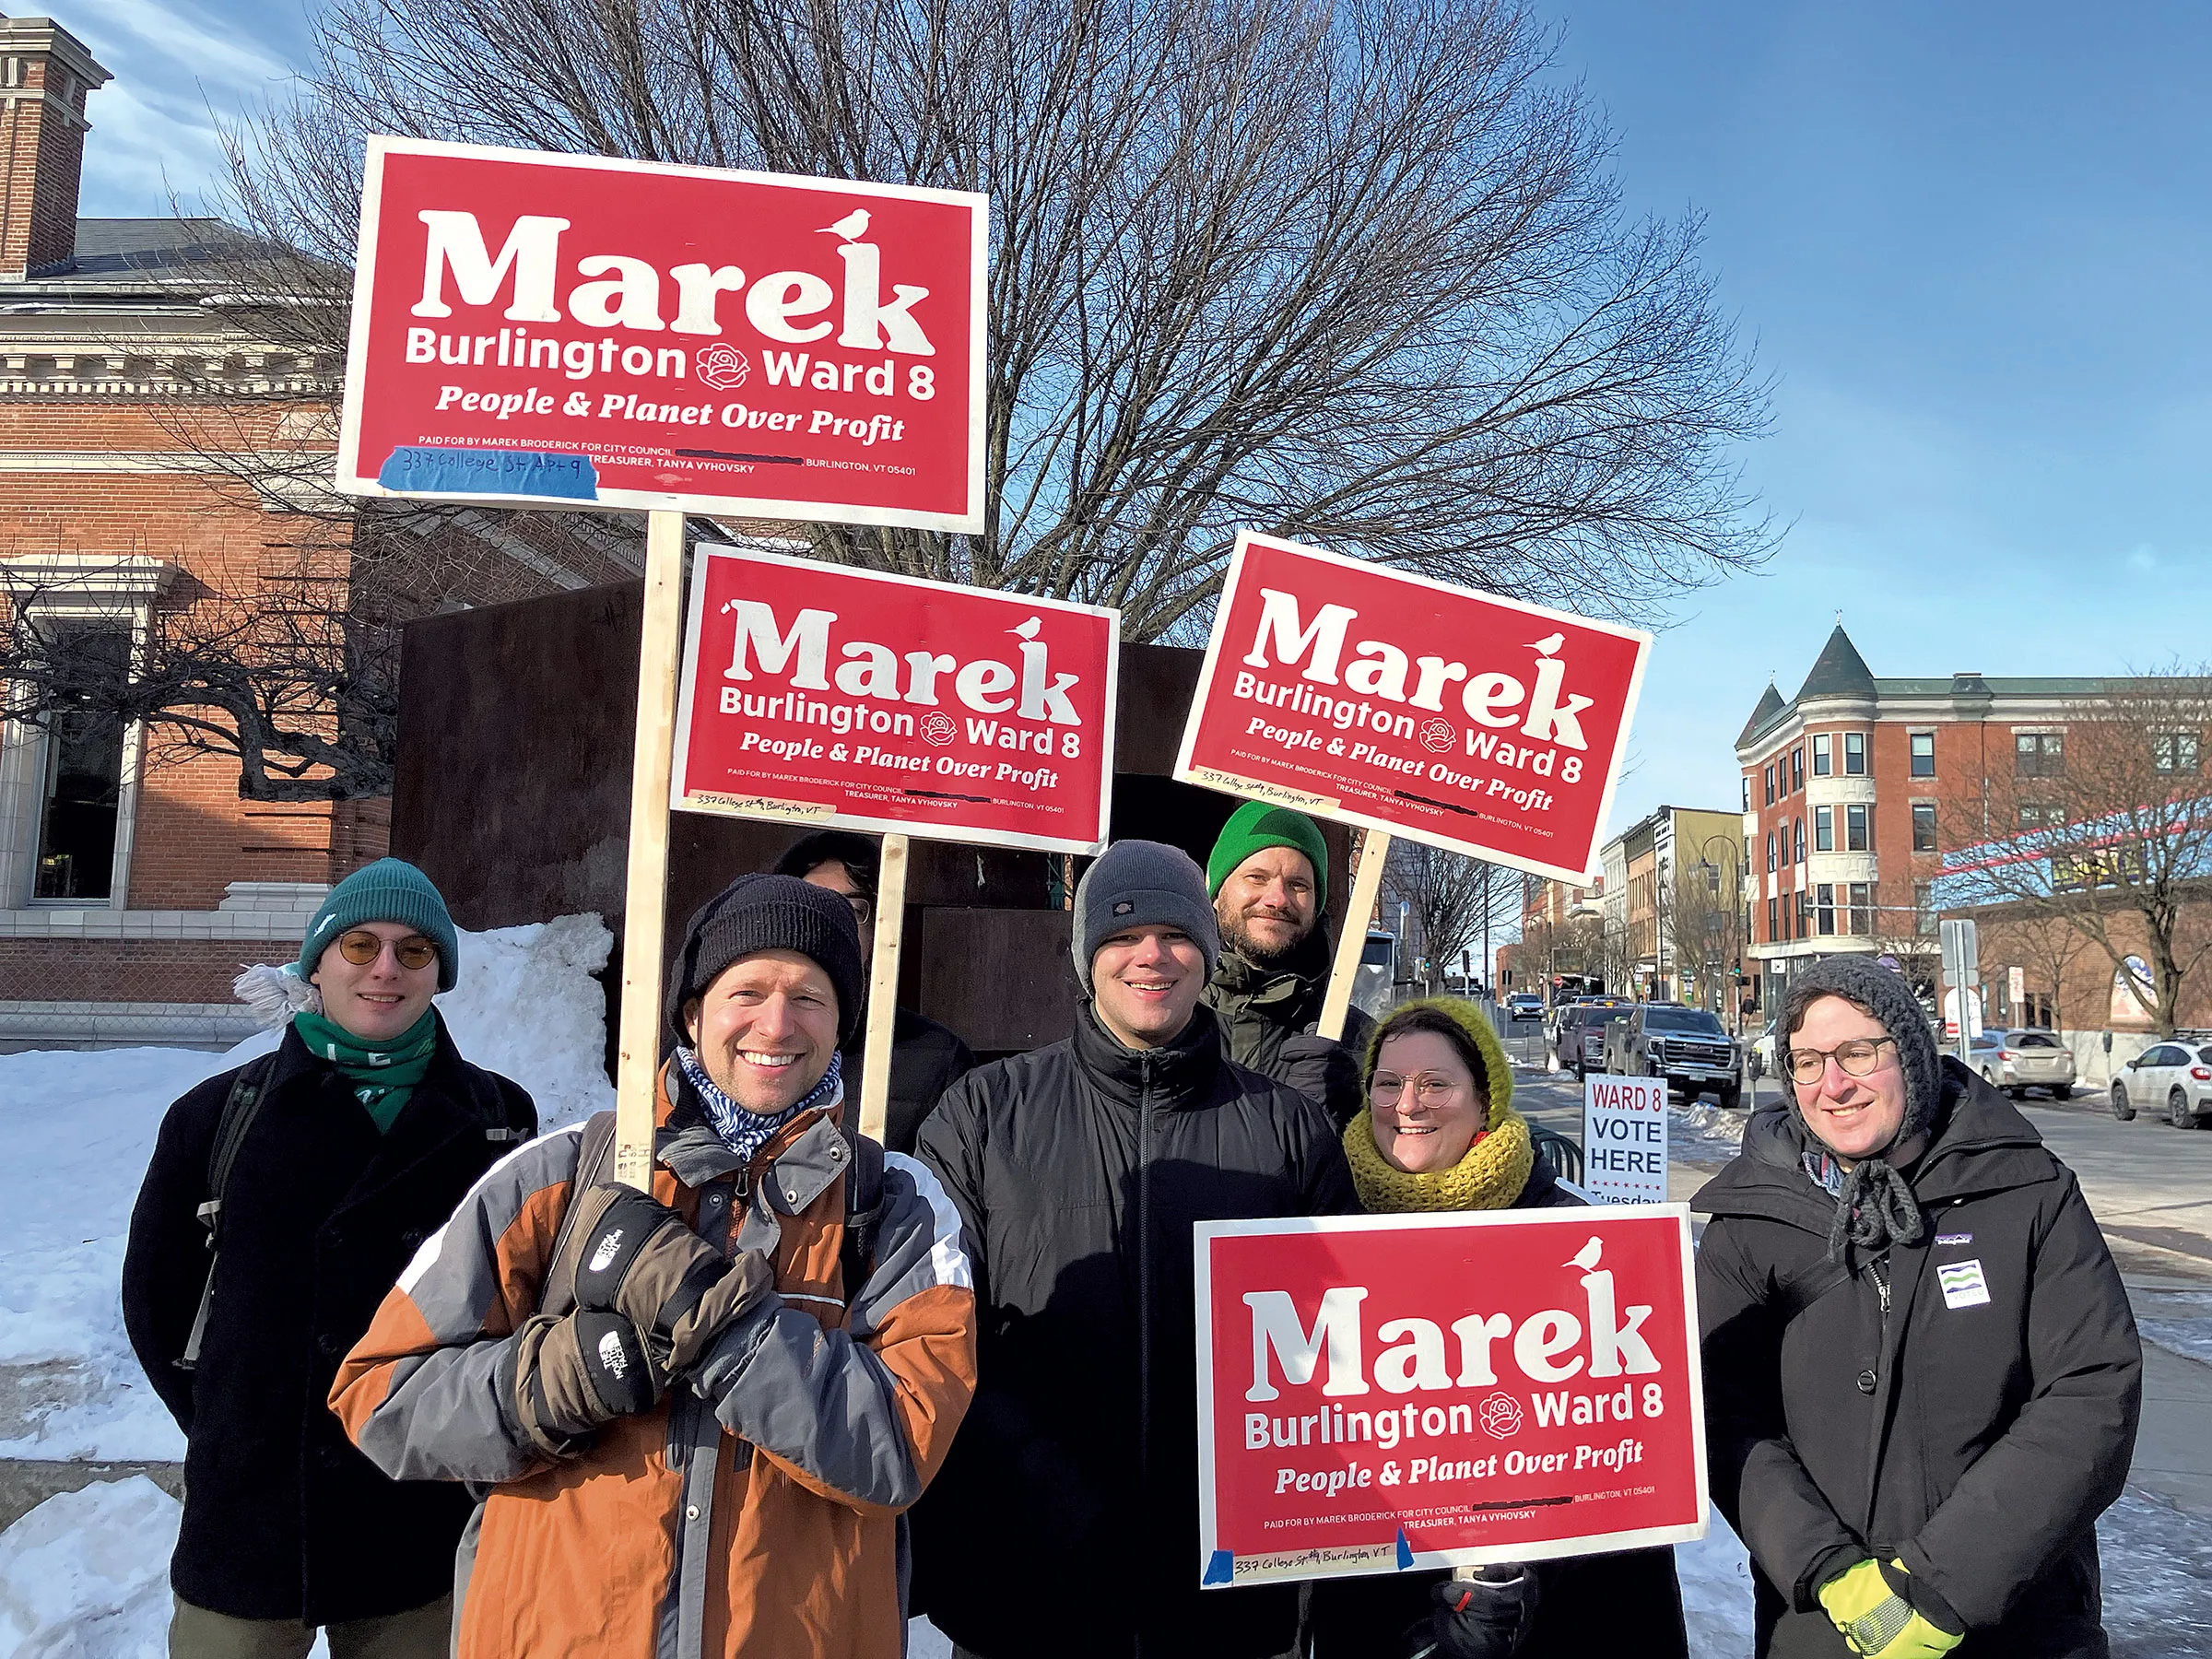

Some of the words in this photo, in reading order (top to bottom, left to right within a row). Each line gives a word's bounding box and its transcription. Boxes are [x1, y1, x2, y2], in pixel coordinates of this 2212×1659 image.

[410, 209, 935, 356] Marek
[405, 326, 686, 380] Burlington
[761, 349, 894, 396] Ward
[907, 364, 935, 400] 8
[434, 385, 554, 420] People
[562, 391, 592, 418] &
[597, 393, 713, 425] Planet
[720, 403, 803, 431] Over
[806, 409, 905, 446] Profit
[403, 449, 433, 471] 337
[439, 453, 499, 472] College
[571, 460, 581, 479] 9
[418, 435, 443, 444] PAID
[443, 436, 465, 445] FOR
[465, 436, 480, 445] BY
[481, 437, 518, 446] MAREK
[520, 438, 579, 453] BRODERICK
[580, 441, 602, 451] FOR
[603, 442, 627, 453] CITY
[872, 464, 886, 472] VT
[886, 465, 915, 476] 05401
[655, 457, 693, 469] TANYA
[695, 461, 754, 473] VYHOVSKY
[723, 598, 1082, 726] Marek
[1241, 587, 1594, 750] Marek
[718, 686, 913, 736] Burlington
[964, 717, 1053, 755] Ward
[1061, 732, 1080, 759] 8
[1232, 670, 1415, 739] Burlington
[1465, 727, 1557, 777] Ward
[1560, 755, 1583, 783] 8
[738, 731, 823, 761] People
[828, 742, 849, 762] &
[852, 745, 931, 771] Planet
[935, 756, 992, 778] Over
[994, 761, 1058, 791] Profit
[1201, 771, 1222, 782] 337
[1244, 716, 1323, 750] People
[1325, 736, 1346, 757] &
[1347, 741, 1425, 776] Planet
[1428, 762, 1483, 791] Over
[1484, 777, 1553, 811] Profit
[697, 794, 717, 805] 337
[726, 767, 746, 775] PAID
[745, 769, 760, 777] FOR
[760, 771, 771, 779] BY
[771, 772, 798, 782] MAREK
[798, 775, 840, 786] BRODERICK
[840, 780, 855, 788] FOR
[854, 782, 872, 790] CITY
[1044, 805, 1064, 813] 05401
[890, 794, 916, 804] TANYA
[916, 797, 958, 808] VYHOVSKY
[1230, 747, 1247, 758] PAID
[1246, 752, 1261, 761] FOR
[1270, 759, 1294, 770] MAREK
[1294, 764, 1333, 779] BRODERICK
[1332, 773, 1347, 782] FOR
[1347, 777, 1363, 786] CITY
[1524, 824, 1533, 832] VT
[1532, 827, 1554, 838] 05401
[1380, 794, 1404, 806] TANYA
[1405, 801, 1444, 817] VYHOVSKY
[1592, 1083, 1646, 1112] WARD
[1652, 1088, 1662, 1112] 8
[1592, 1116, 1662, 1144] VOTE
[1591, 1147, 1662, 1175] HERE
[1591, 1190, 1662, 1205] Tuesda
[1953, 1289, 1984, 1300] VOTED
[1241, 1268, 1661, 1402] Marek
[1244, 1402, 1473, 1450] Burlington
[1530, 1382, 1633, 1428] Ward
[1641, 1382, 1664, 1418] 8
[1274, 1461, 1371, 1497] People
[1378, 1460, 1402, 1486] &
[1407, 1453, 1498, 1484] Planet
[1503, 1450, 1568, 1475] Over
[1572, 1438, 1643, 1473] Profit
[1264, 1519, 1284, 1529] PAID
[1284, 1517, 1302, 1527] FOR
[1302, 1516, 1314, 1525] BY
[1315, 1514, 1347, 1524] MAREK
[1347, 1511, 1396, 1522] BRODERICK
[1396, 1509, 1414, 1518] FOR
[1414, 1507, 1433, 1517] CITY
[1622, 1488, 1632, 1496] VT
[1632, 1485, 1655, 1495] 05401
[1457, 1513, 1488, 1524] TANYA
[1488, 1510, 1535, 1522] VYHOVSKY
[1235, 1560, 1259, 1574] 337
[1262, 1557, 1293, 1569] College
